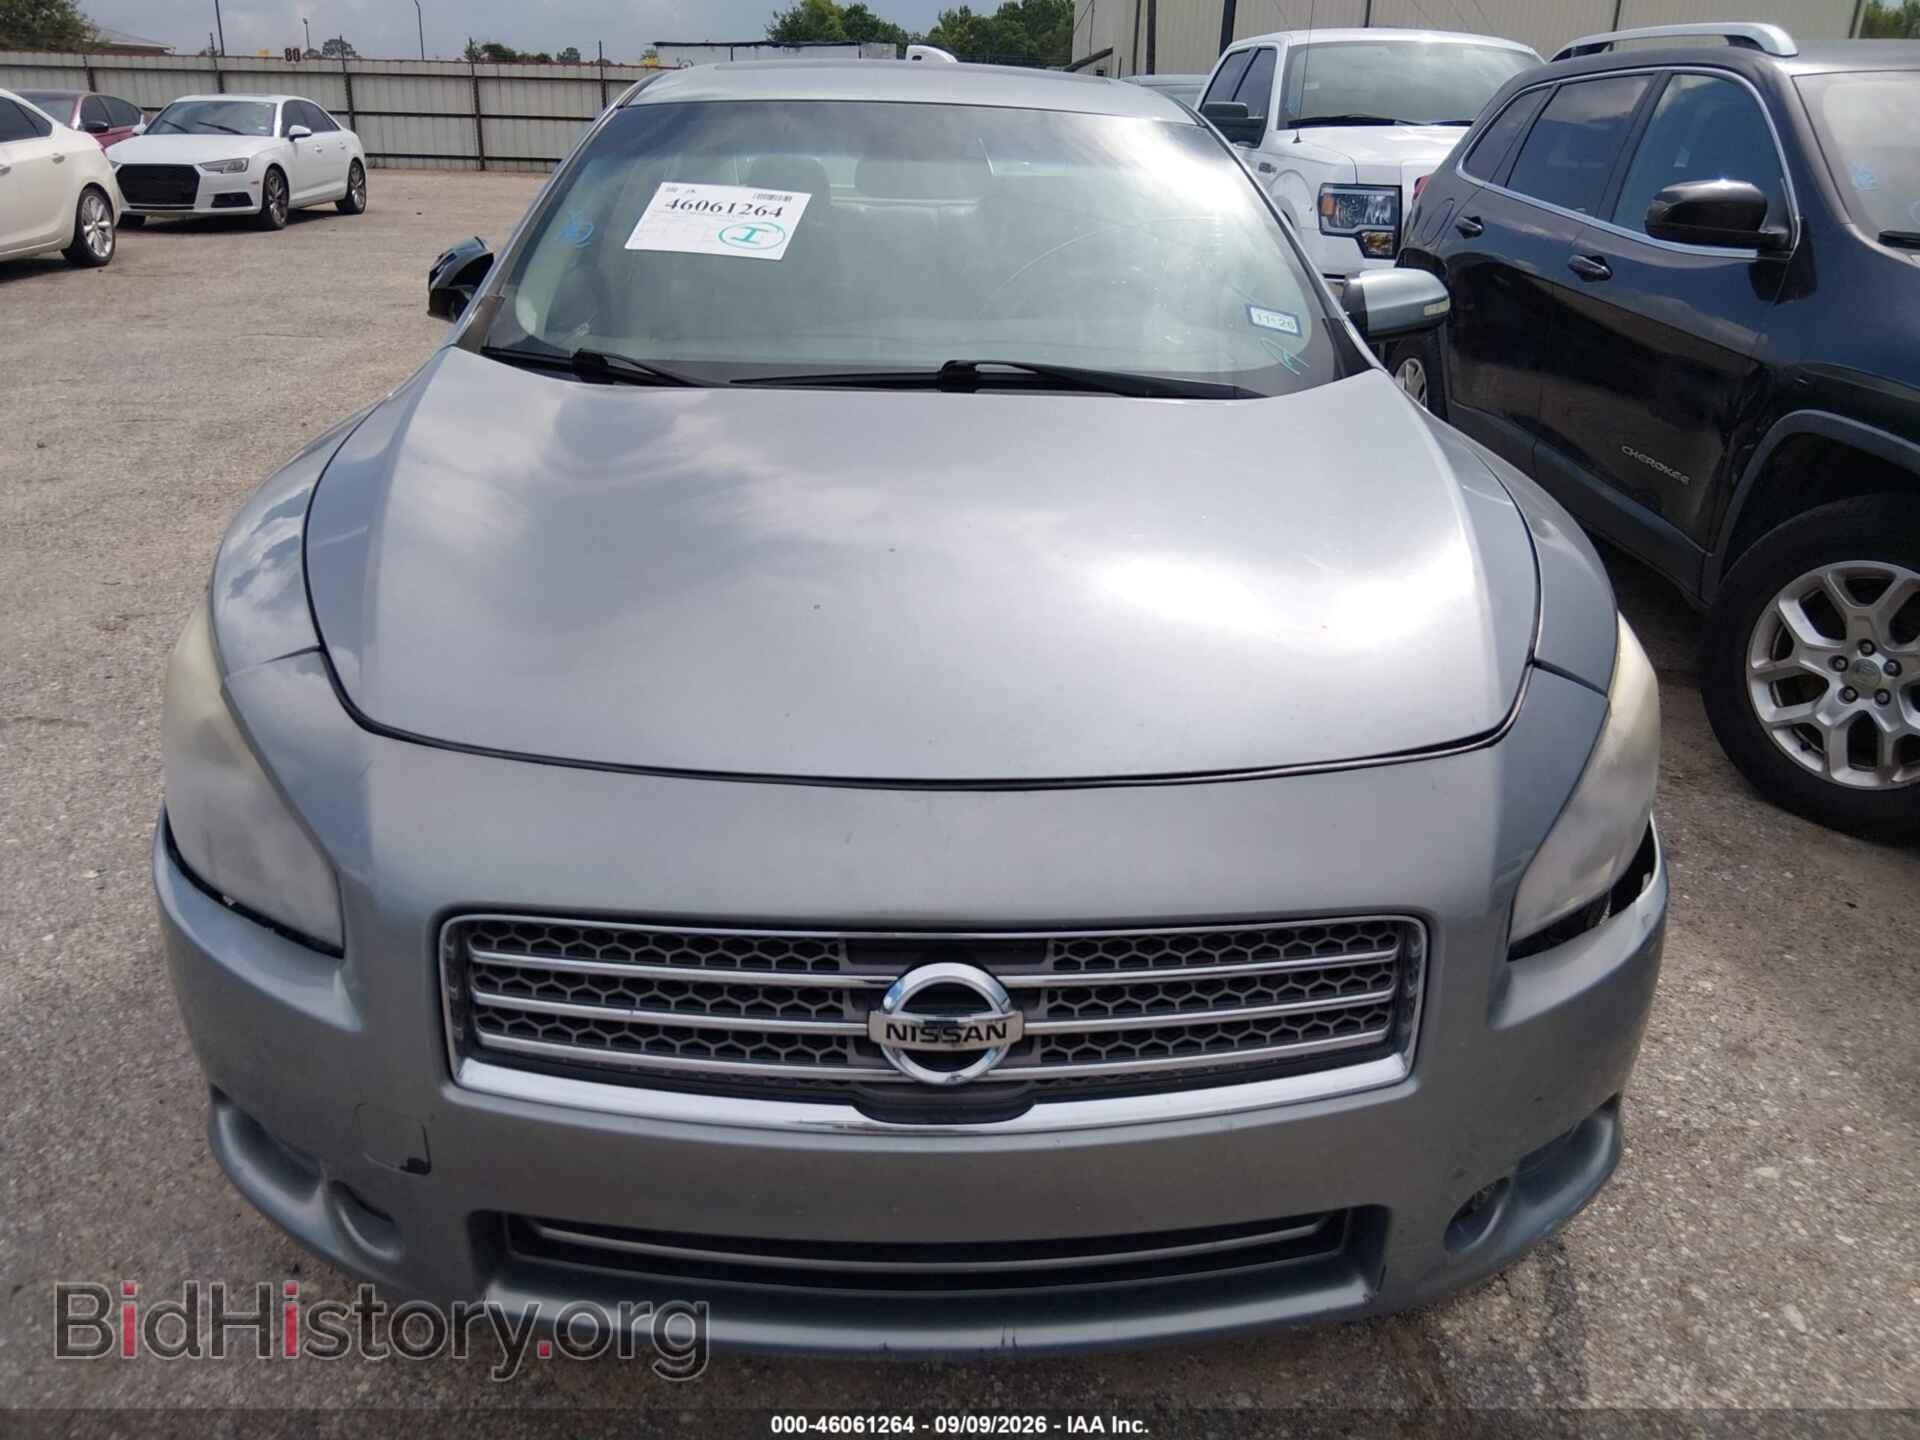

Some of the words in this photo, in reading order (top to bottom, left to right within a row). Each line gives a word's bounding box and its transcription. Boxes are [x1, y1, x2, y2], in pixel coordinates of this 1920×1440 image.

[664, 198, 784, 218] 46061264
[1621, 445, 1690, 486] CHEROKEE
[885, 1021, 1007, 1044] NISSAN
